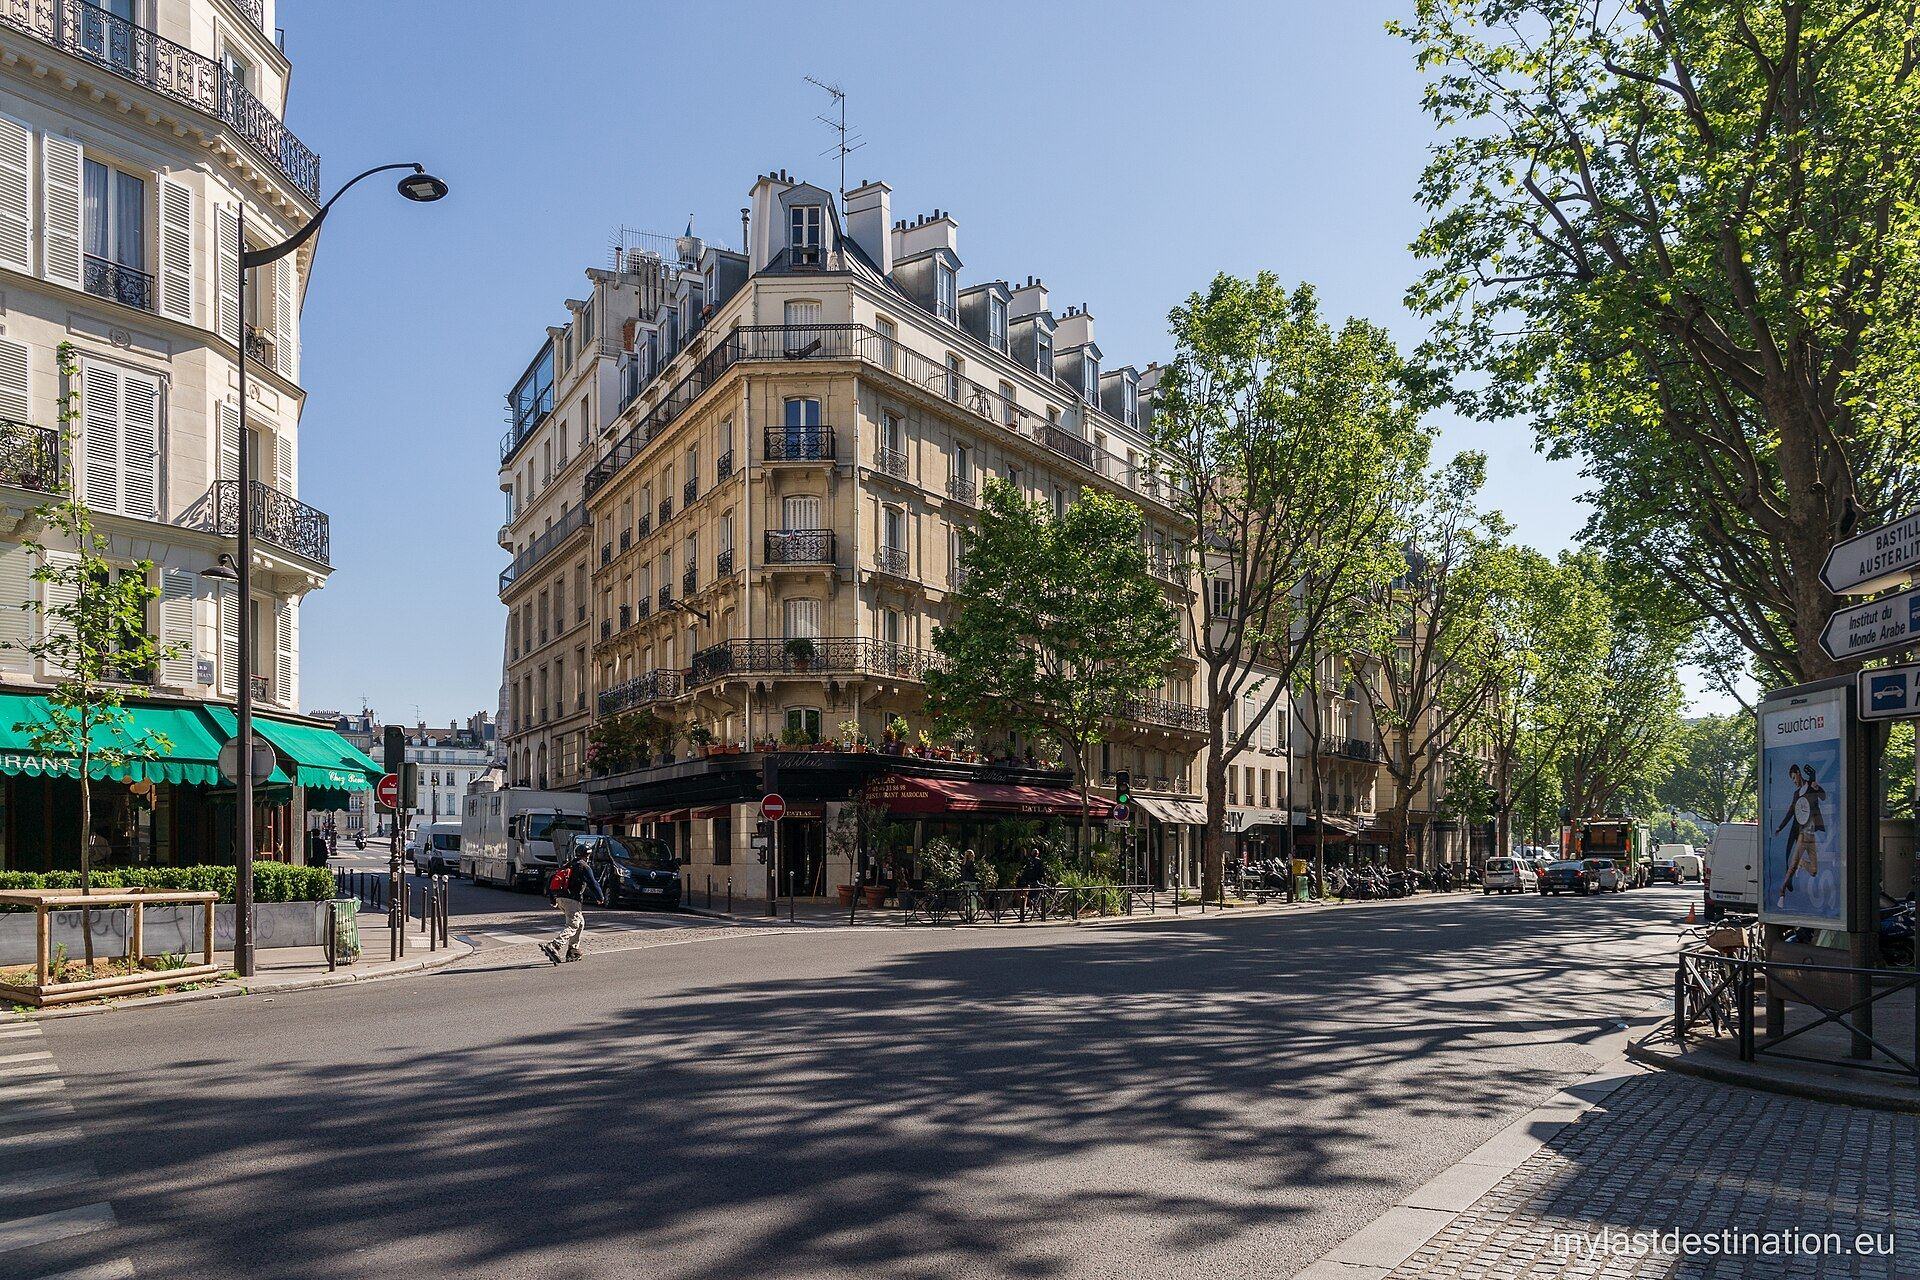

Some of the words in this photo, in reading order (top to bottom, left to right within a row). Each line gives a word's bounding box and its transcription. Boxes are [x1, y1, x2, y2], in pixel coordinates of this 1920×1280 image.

[1849, 610, 1878, 630] Institut
[1882, 605, 1892, 620] du
[1848, 629, 1877, 648] Monde
[1880, 621, 1906, 640] Arabe
[1777, 715, 1817, 734] swatch
[0, 754, 76, 771] RANT
[329, 771, 345, 786] Chez
